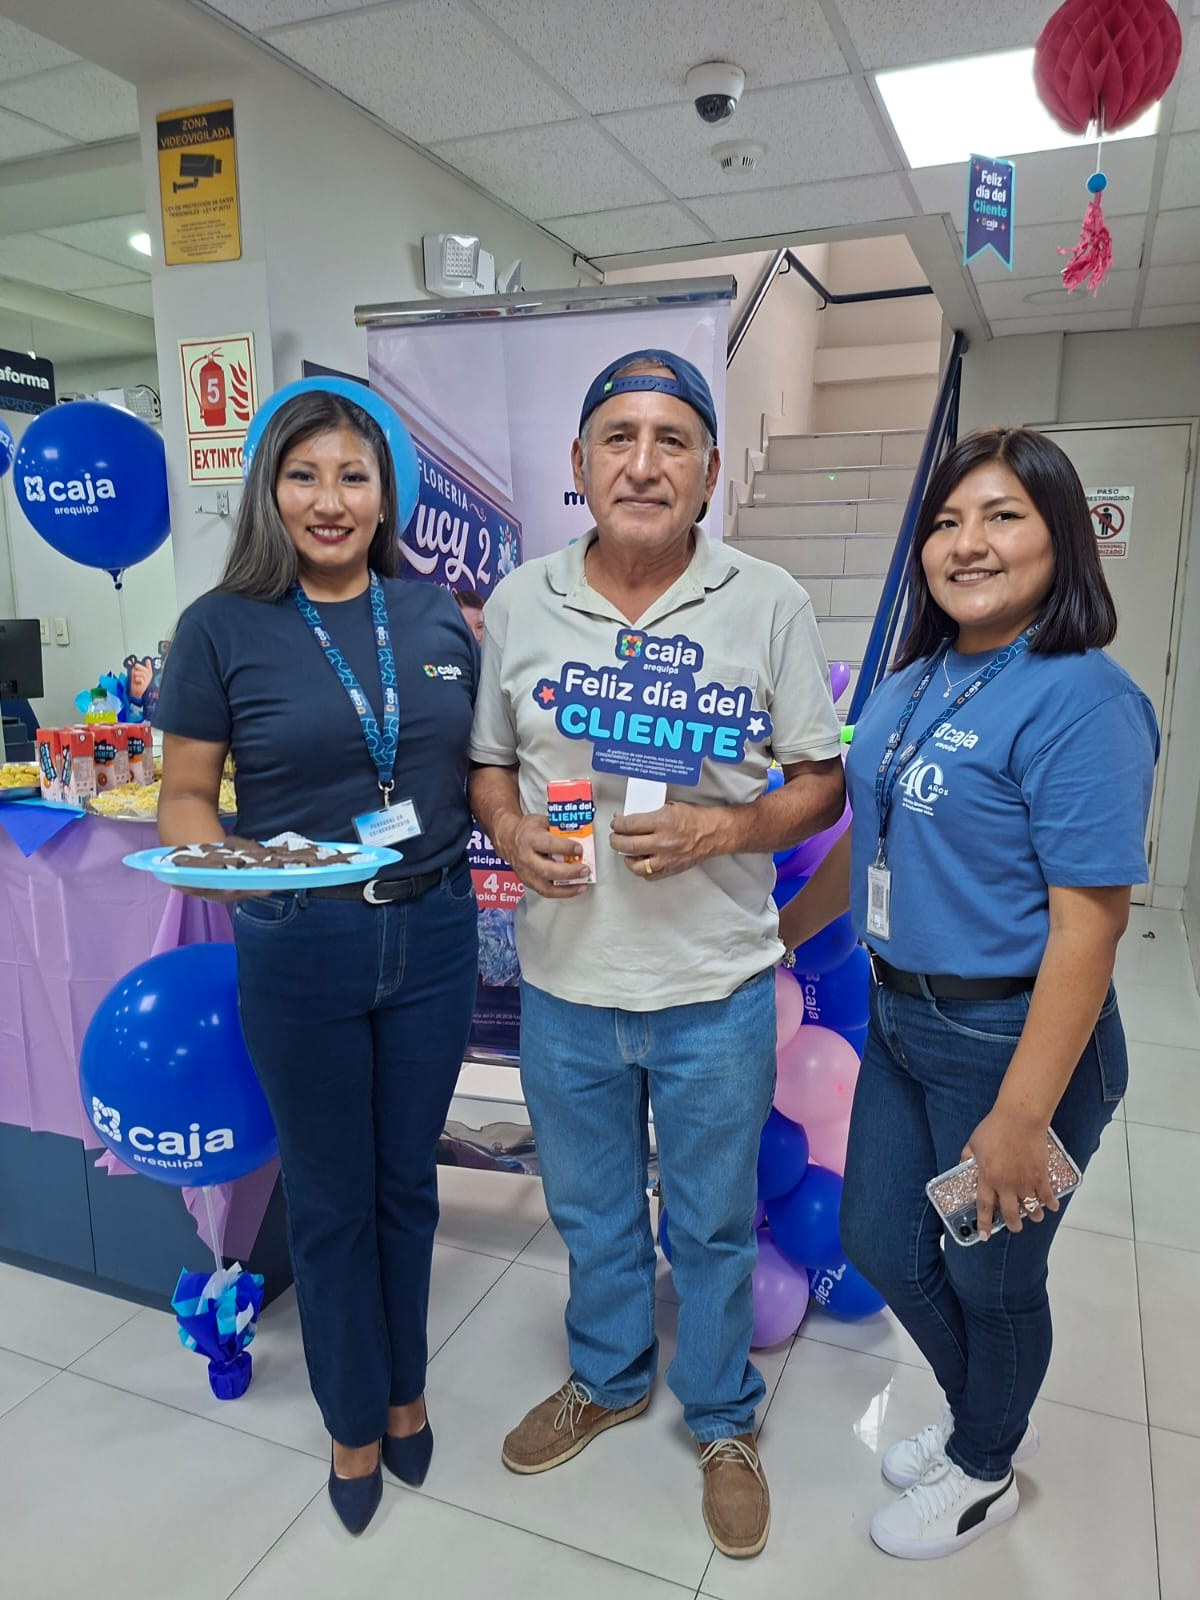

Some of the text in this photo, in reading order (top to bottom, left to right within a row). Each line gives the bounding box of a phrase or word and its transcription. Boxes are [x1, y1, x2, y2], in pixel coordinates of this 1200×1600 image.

[182, 116, 208, 131] ZONA
[160, 126, 232, 149] VIDEOVIGILADA
[981, 169, 1003, 187] Feliz
[975, 184, 1006, 203] día del
[973, 199, 1008, 218] Cliente
[207, 378, 221, 404] 5
[48, 472, 117, 505] caja
[54, 503, 99, 517] arequipa
[476, 527, 491, 585] 2
[644, 641, 697, 667] caja
[437, 663, 463, 678] caja
[643, 663, 679, 675] arequipa
[565, 668, 746, 719] Feliz día del
[964, 680, 983, 698] caja
[561, 703, 741, 758] CLIENTE
[943, 728, 979, 750] caja
[899, 755, 944, 804] 40
[927, 784, 949, 797] AÑOS
[483, 873, 499, 893] 4
[805, 984, 821, 1020] caja
[128, 1123, 235, 1160] caja
[133, 1153, 203, 1170] arequipa
